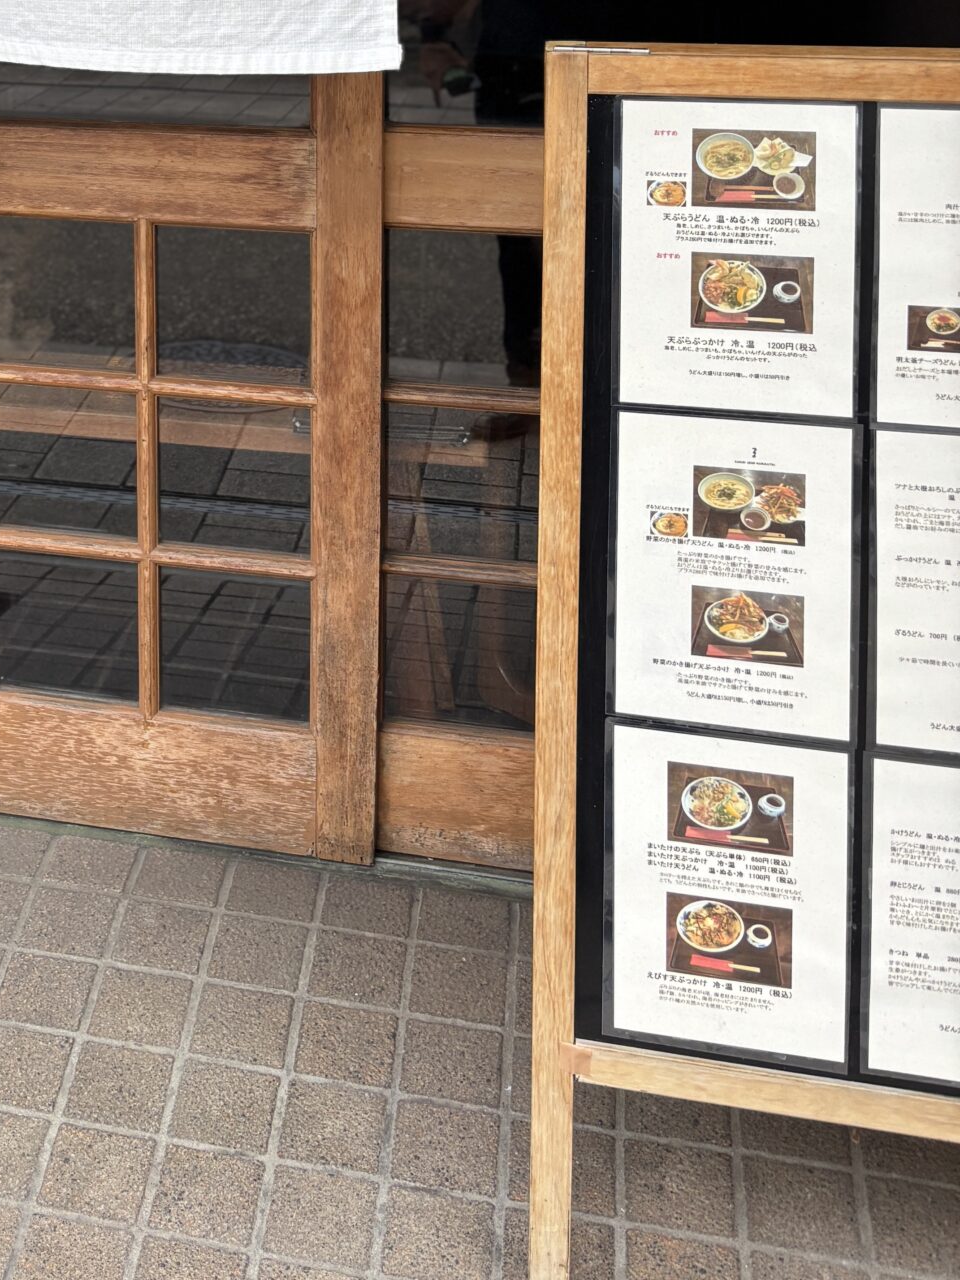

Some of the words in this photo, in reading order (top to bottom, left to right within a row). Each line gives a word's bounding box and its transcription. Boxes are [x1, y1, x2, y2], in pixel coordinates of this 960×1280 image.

[654, 129, 678, 137] おすすめ
[662, 212, 710, 223] 天ぷらうどん
[656, 252, 681, 260] おすすめ
[667, 335, 726, 347] 天ぷらぶっかけ
[755, 545, 776, 554] 1200円
[894, 629, 924, 638] ざるうどん
[756, 670, 777, 679] 1200円
[647, 842, 701, 856] まいたけの天ぷら
[647, 850, 707, 865] まいたけ天ぶっかけ
[647, 859, 699, 872] まいたけ天うどん
[749, 873, 770, 882] 1100円
[647, 971, 707, 987] えびす天ぶっかけ
[739, 985, 763, 995] 1200円
